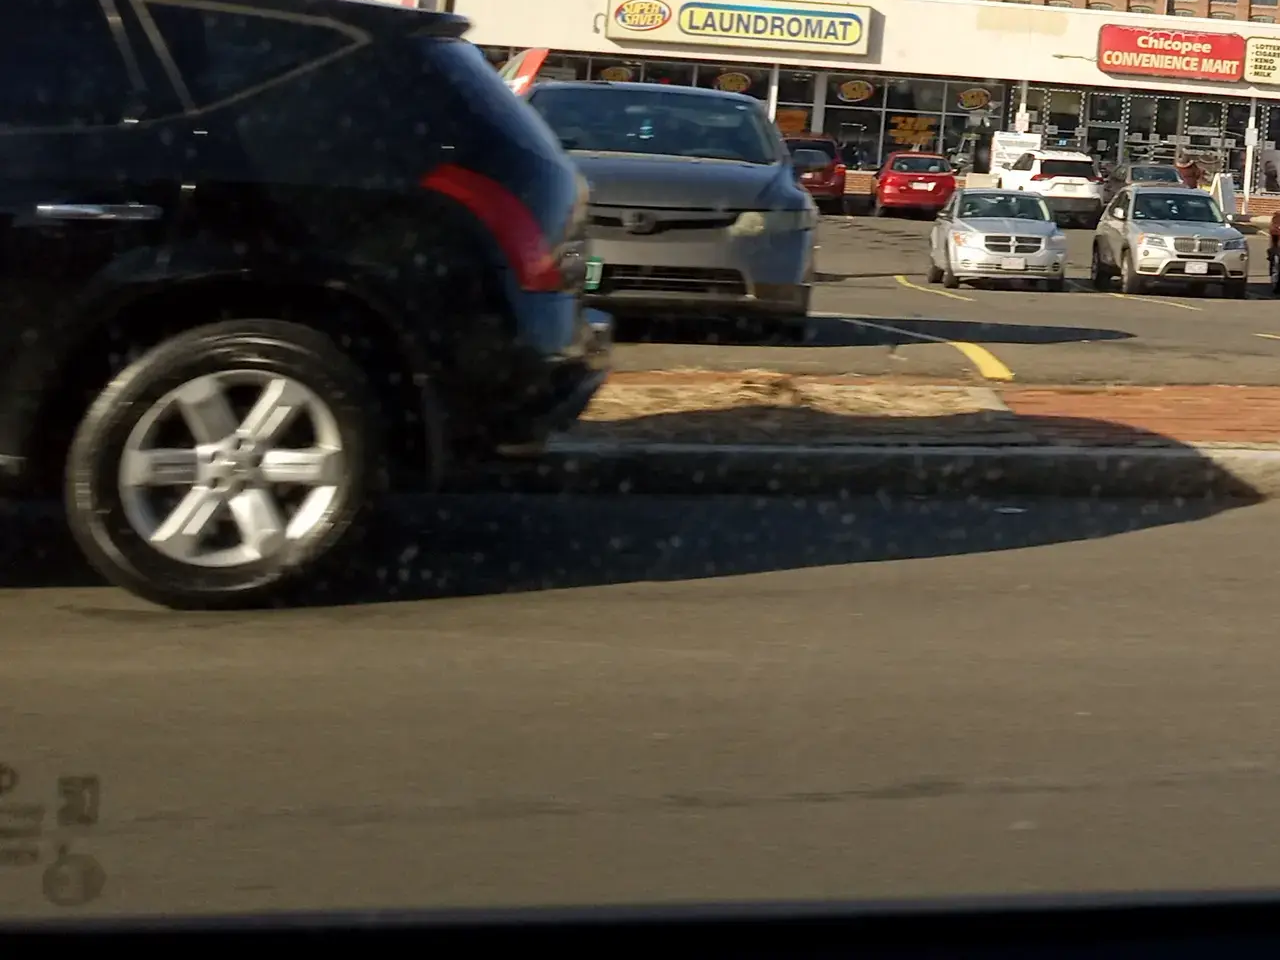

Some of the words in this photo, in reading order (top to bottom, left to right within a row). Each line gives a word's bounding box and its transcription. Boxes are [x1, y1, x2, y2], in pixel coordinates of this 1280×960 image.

[625, 2, 660, 14] SUPER
[626, 14, 663, 25] SAVER
[688, 11, 852, 41] LAUNDROMAT
[1137, 36, 1212, 54] Chicopee
[1103, 50, 1199, 71] CONVENIENCE
[1201, 58, 1239, 74] MART
